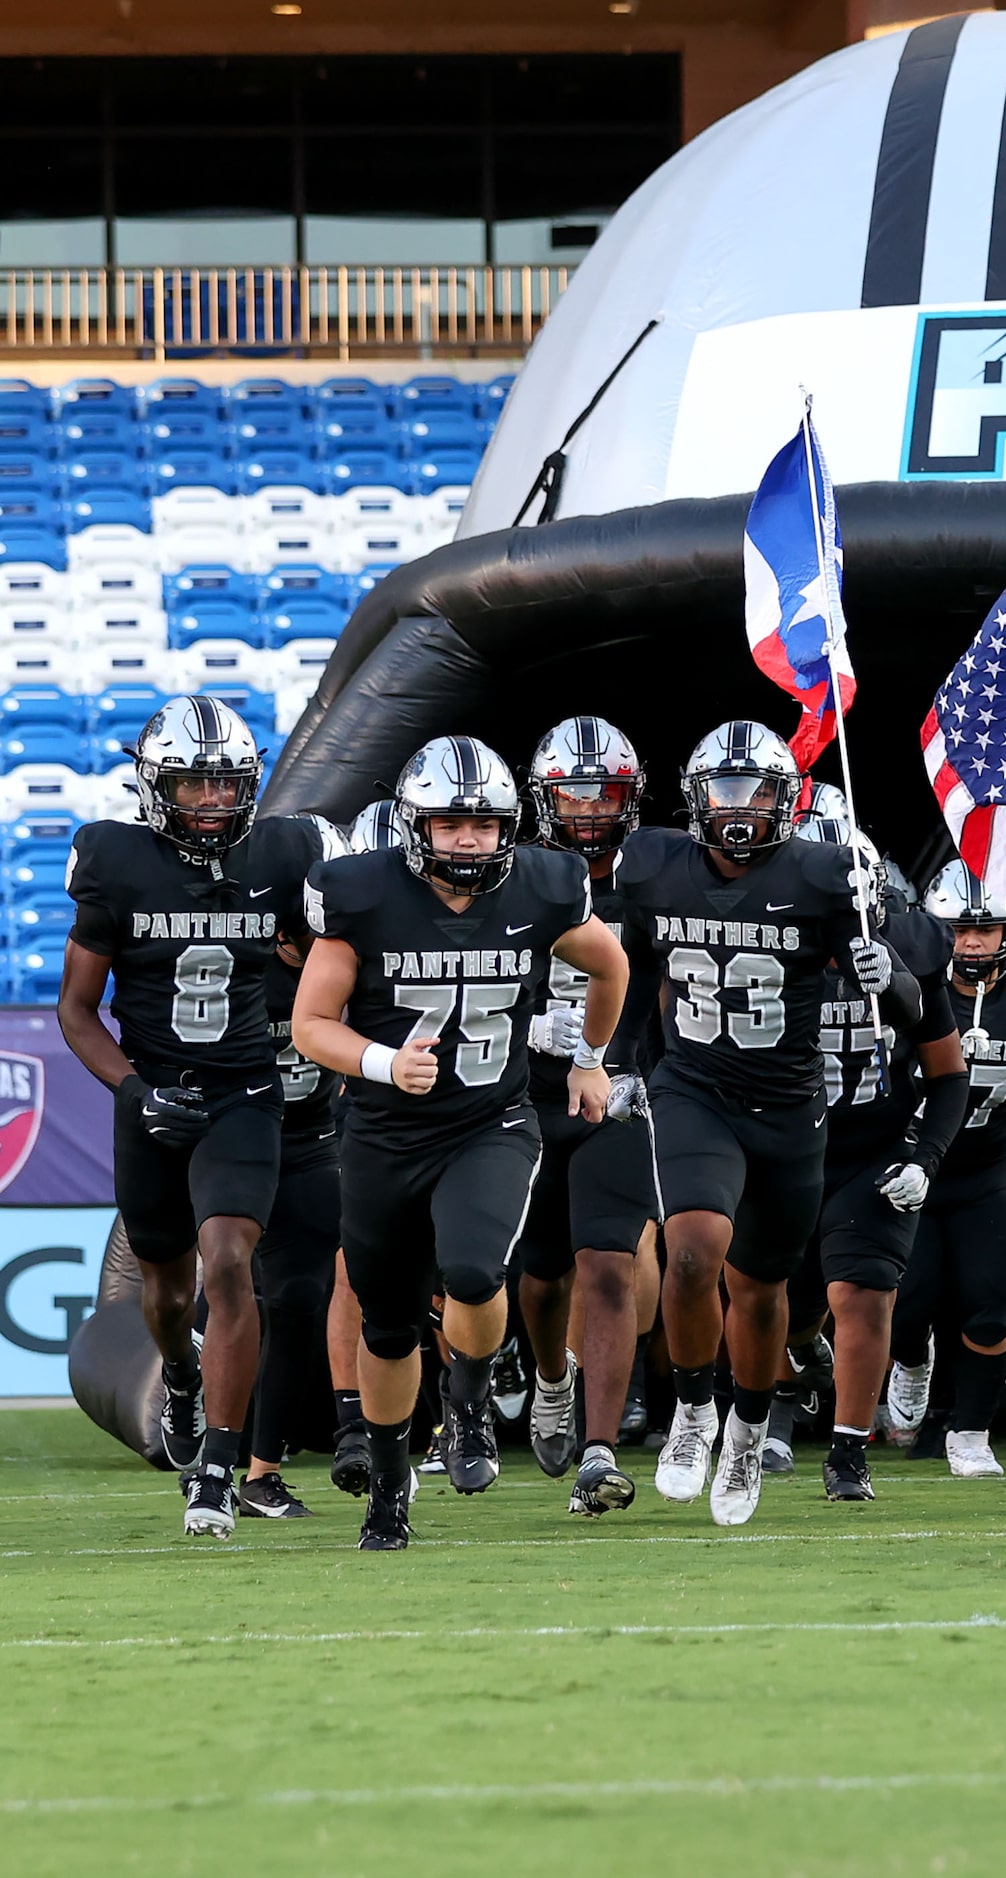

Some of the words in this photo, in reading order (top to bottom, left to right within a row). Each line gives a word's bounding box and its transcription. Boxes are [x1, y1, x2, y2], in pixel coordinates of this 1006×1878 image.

[132, 912, 277, 939] PANTHERS
[382, 949, 533, 979] PANTHERS
[655, 915, 801, 951] PANTHERS
[172, 944, 235, 1043] 8
[394, 983, 523, 1087] 75
[667, 947, 786, 1050] 33
[0, 1246, 94, 1355] G
